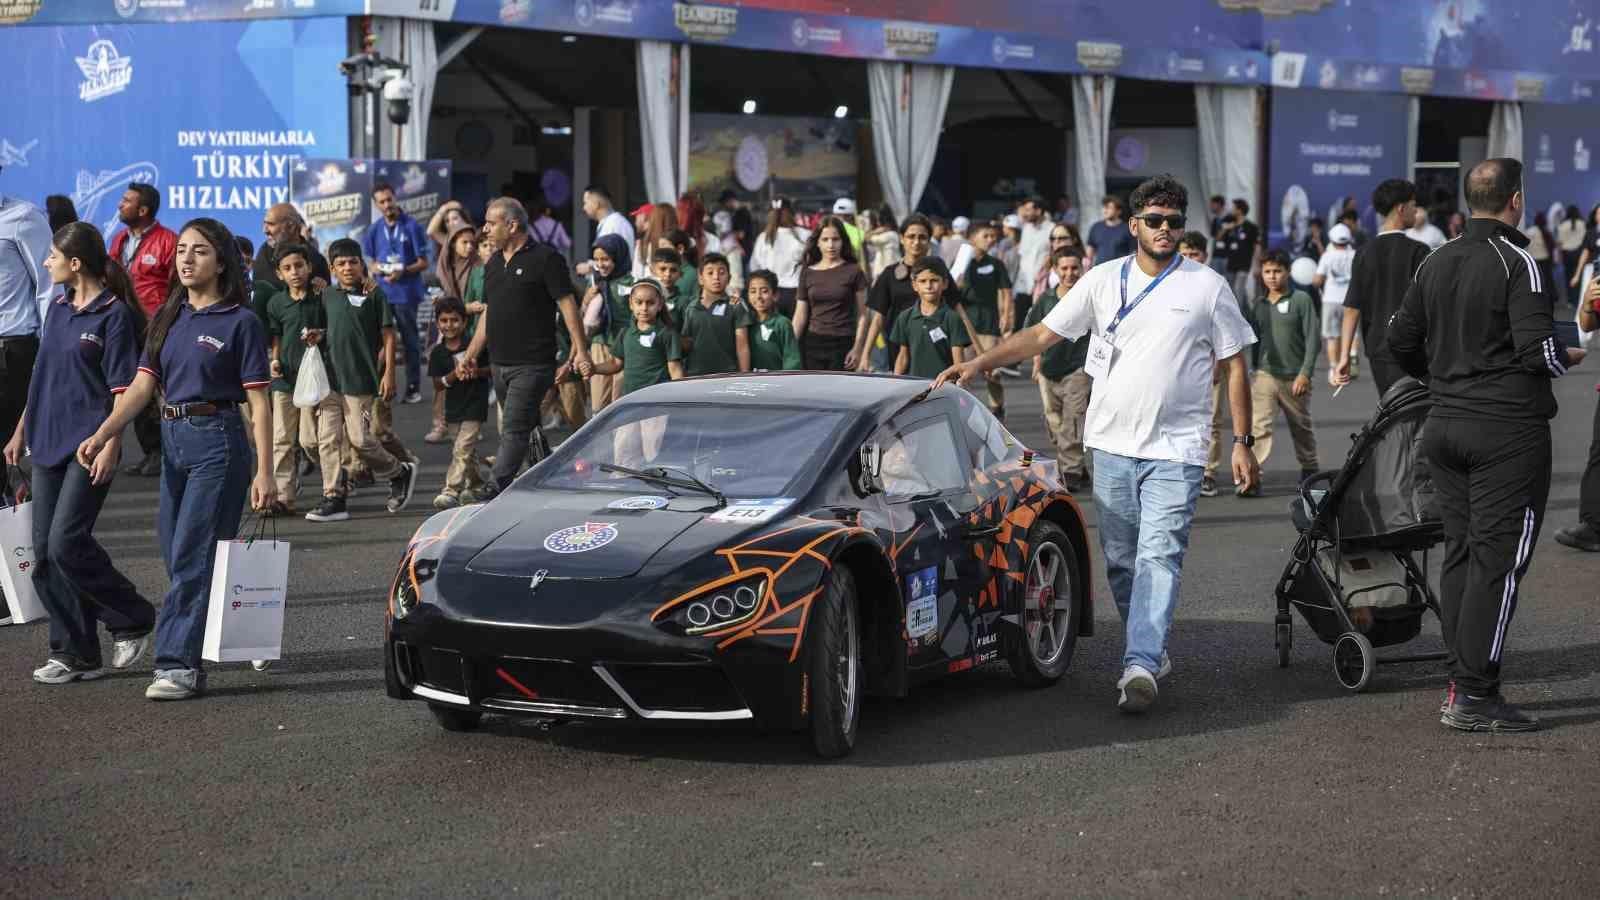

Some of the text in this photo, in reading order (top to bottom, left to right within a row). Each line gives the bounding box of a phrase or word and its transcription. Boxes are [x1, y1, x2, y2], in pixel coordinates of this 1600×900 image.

[177, 131, 316, 147] DEV YATIRIMLARLA
[727, 508, 768, 518] E13
